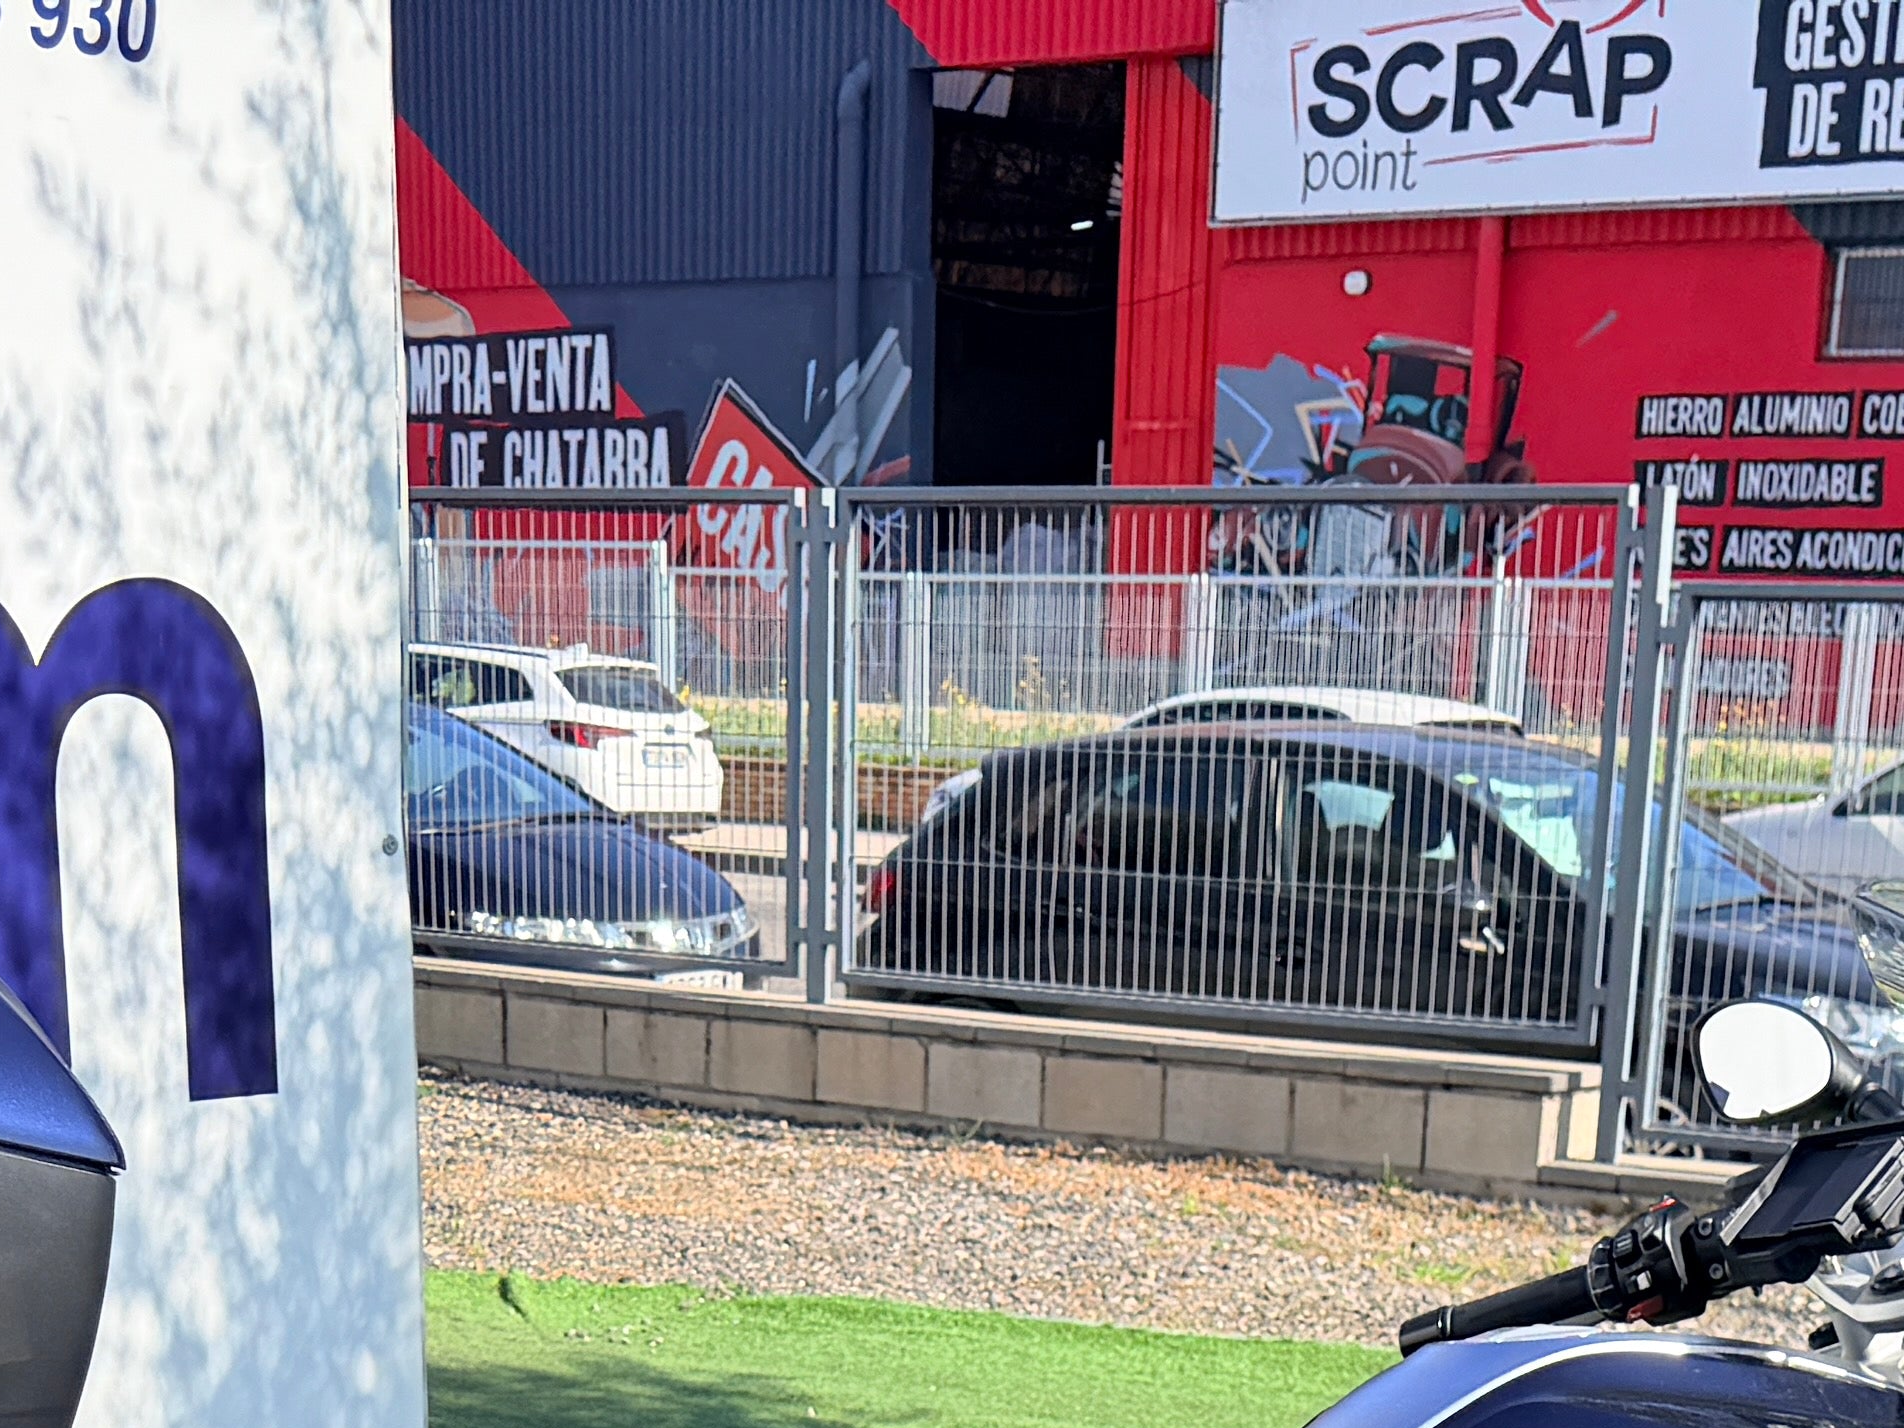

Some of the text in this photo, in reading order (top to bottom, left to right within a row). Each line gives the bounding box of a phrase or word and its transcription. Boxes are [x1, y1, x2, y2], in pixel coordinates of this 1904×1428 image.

[1308, 20, 1672, 138] SCRAP
[1787, 82, 1842, 159] DE
[1302, 139, 1418, 203] point
[1641, 397, 1724, 437] HIERRO
[1732, 394, 1850, 436] ALUMINIO
[450, 426, 671, 488] DE CHATARRA
[1737, 462, 1878, 502] INOXIDABLE
[1722, 528, 1794, 568] AIRES
